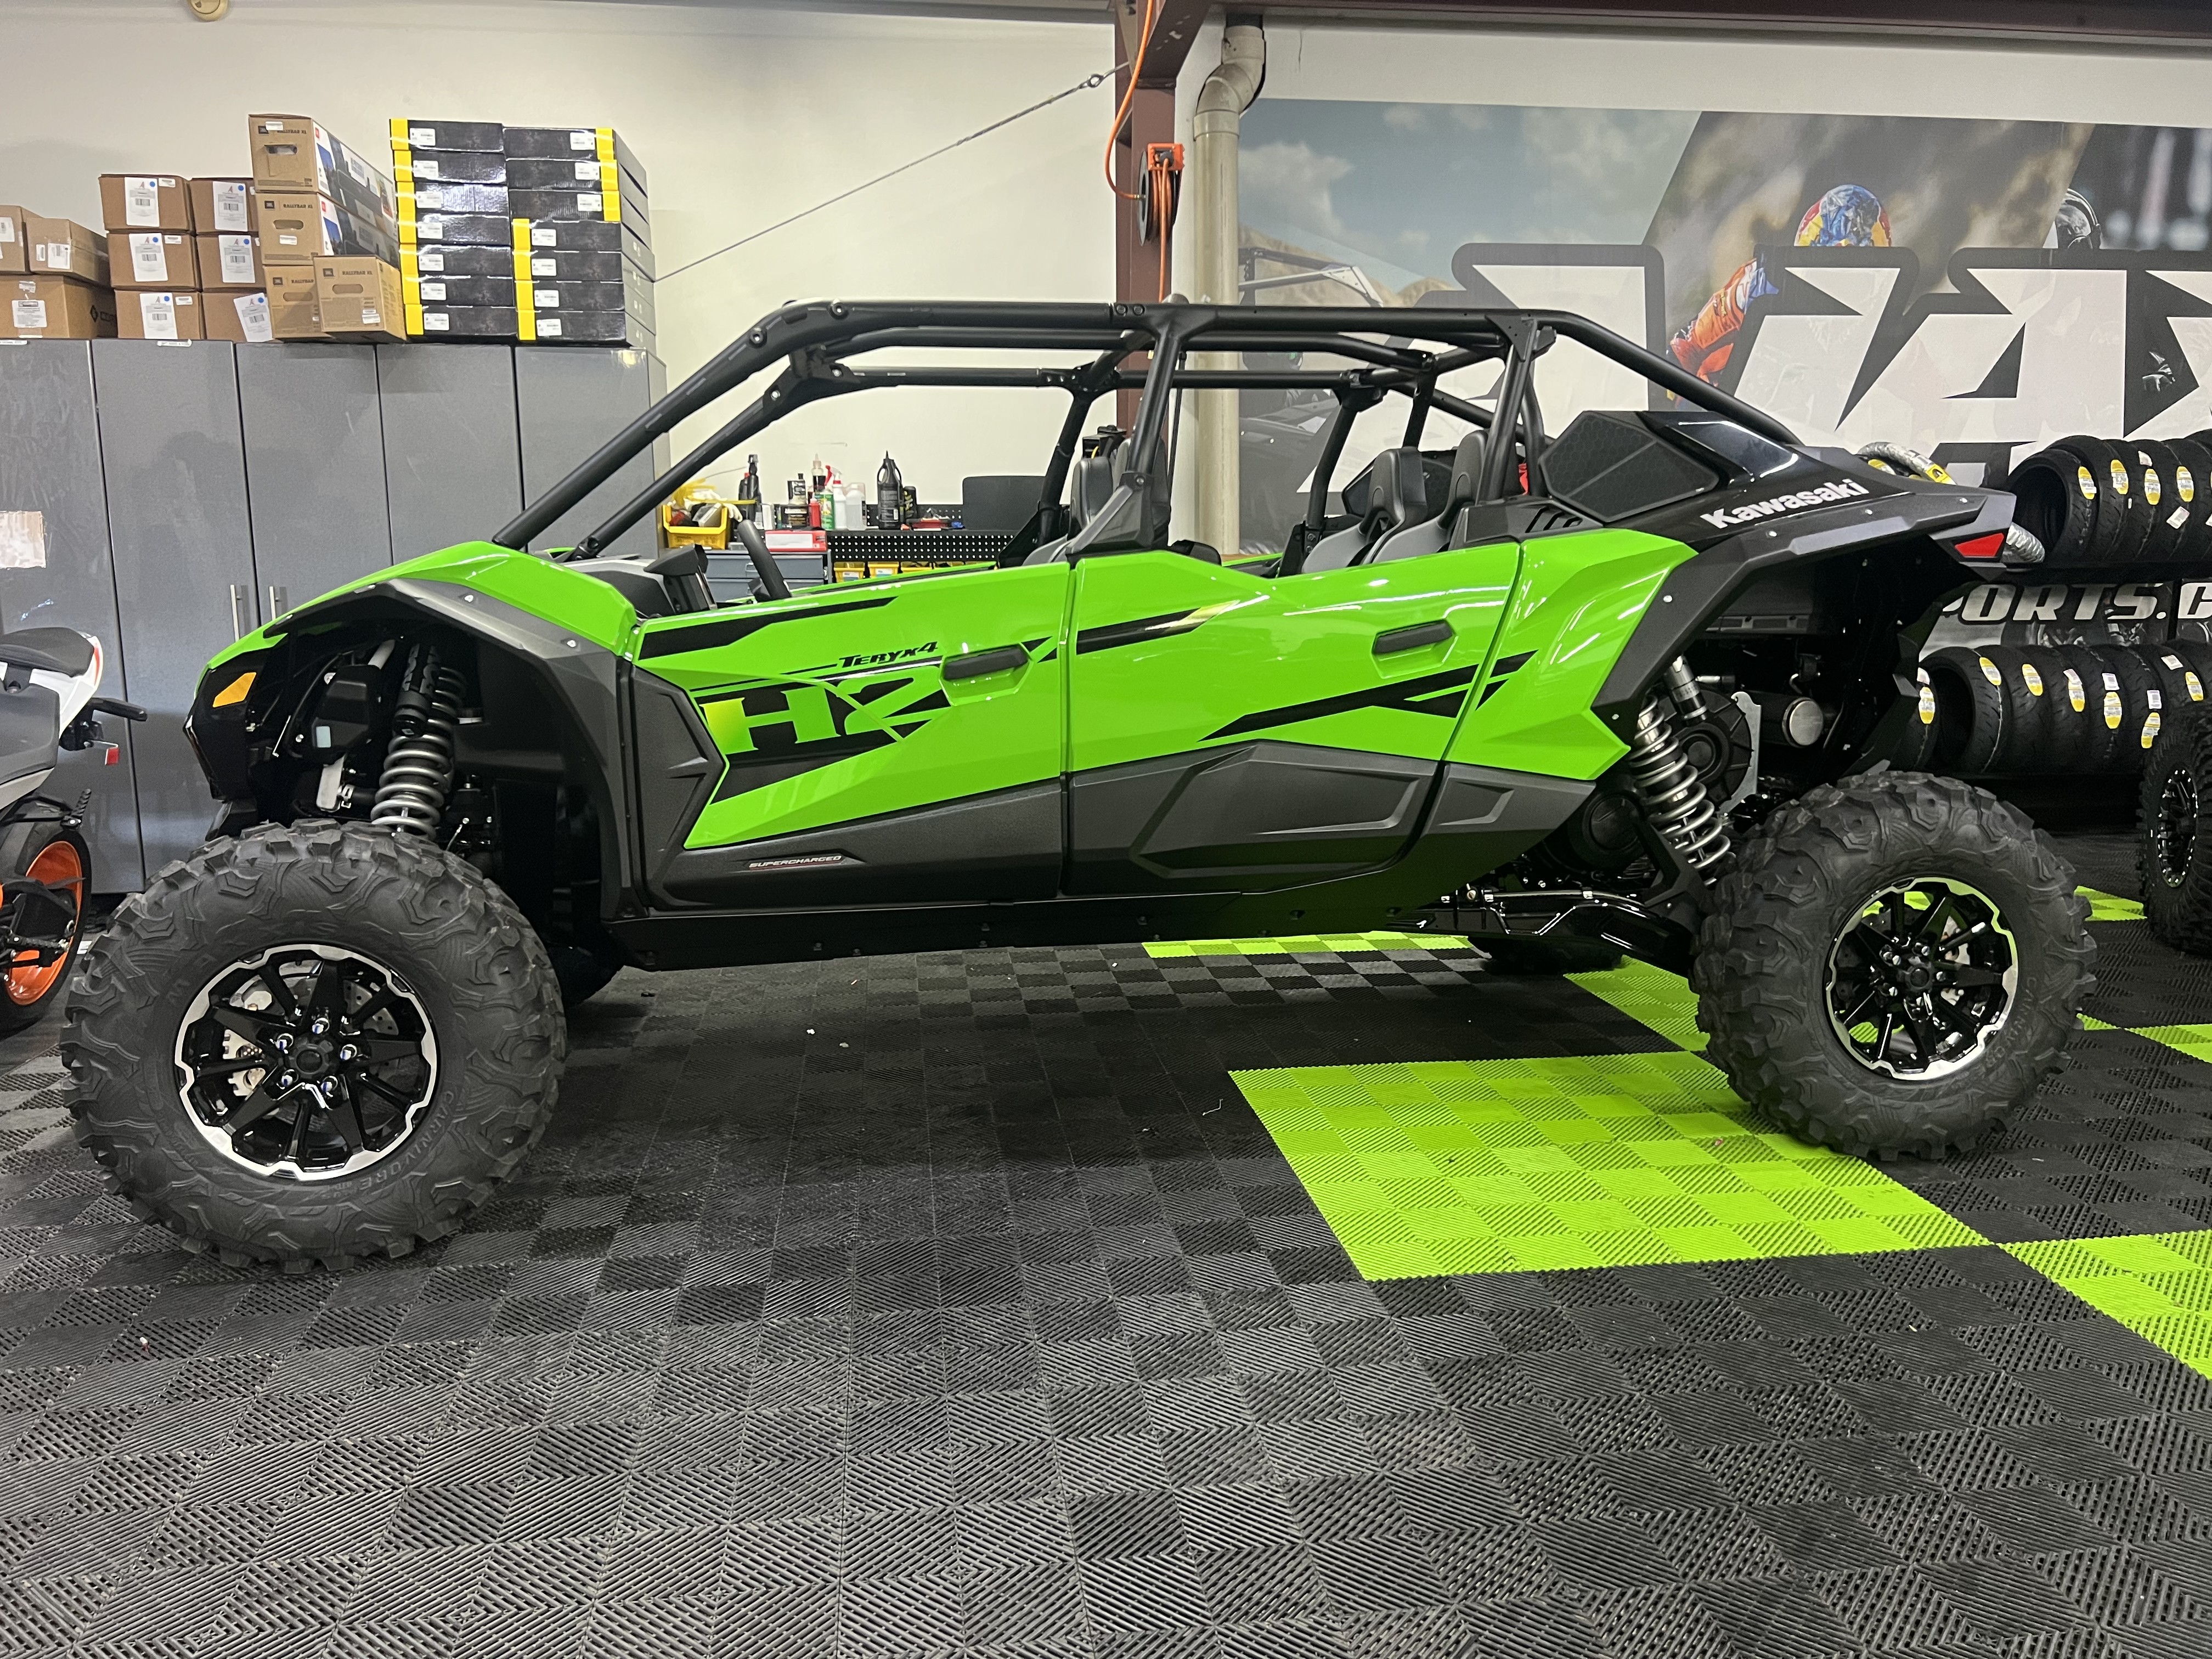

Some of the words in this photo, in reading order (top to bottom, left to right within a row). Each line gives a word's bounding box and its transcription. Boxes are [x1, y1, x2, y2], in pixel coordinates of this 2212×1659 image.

[1700, 478, 1869, 529] Kawasaki
[749, 855, 842, 868] SUPERCHARGED
[358, 1088, 456, 1192] CARNIVORE
